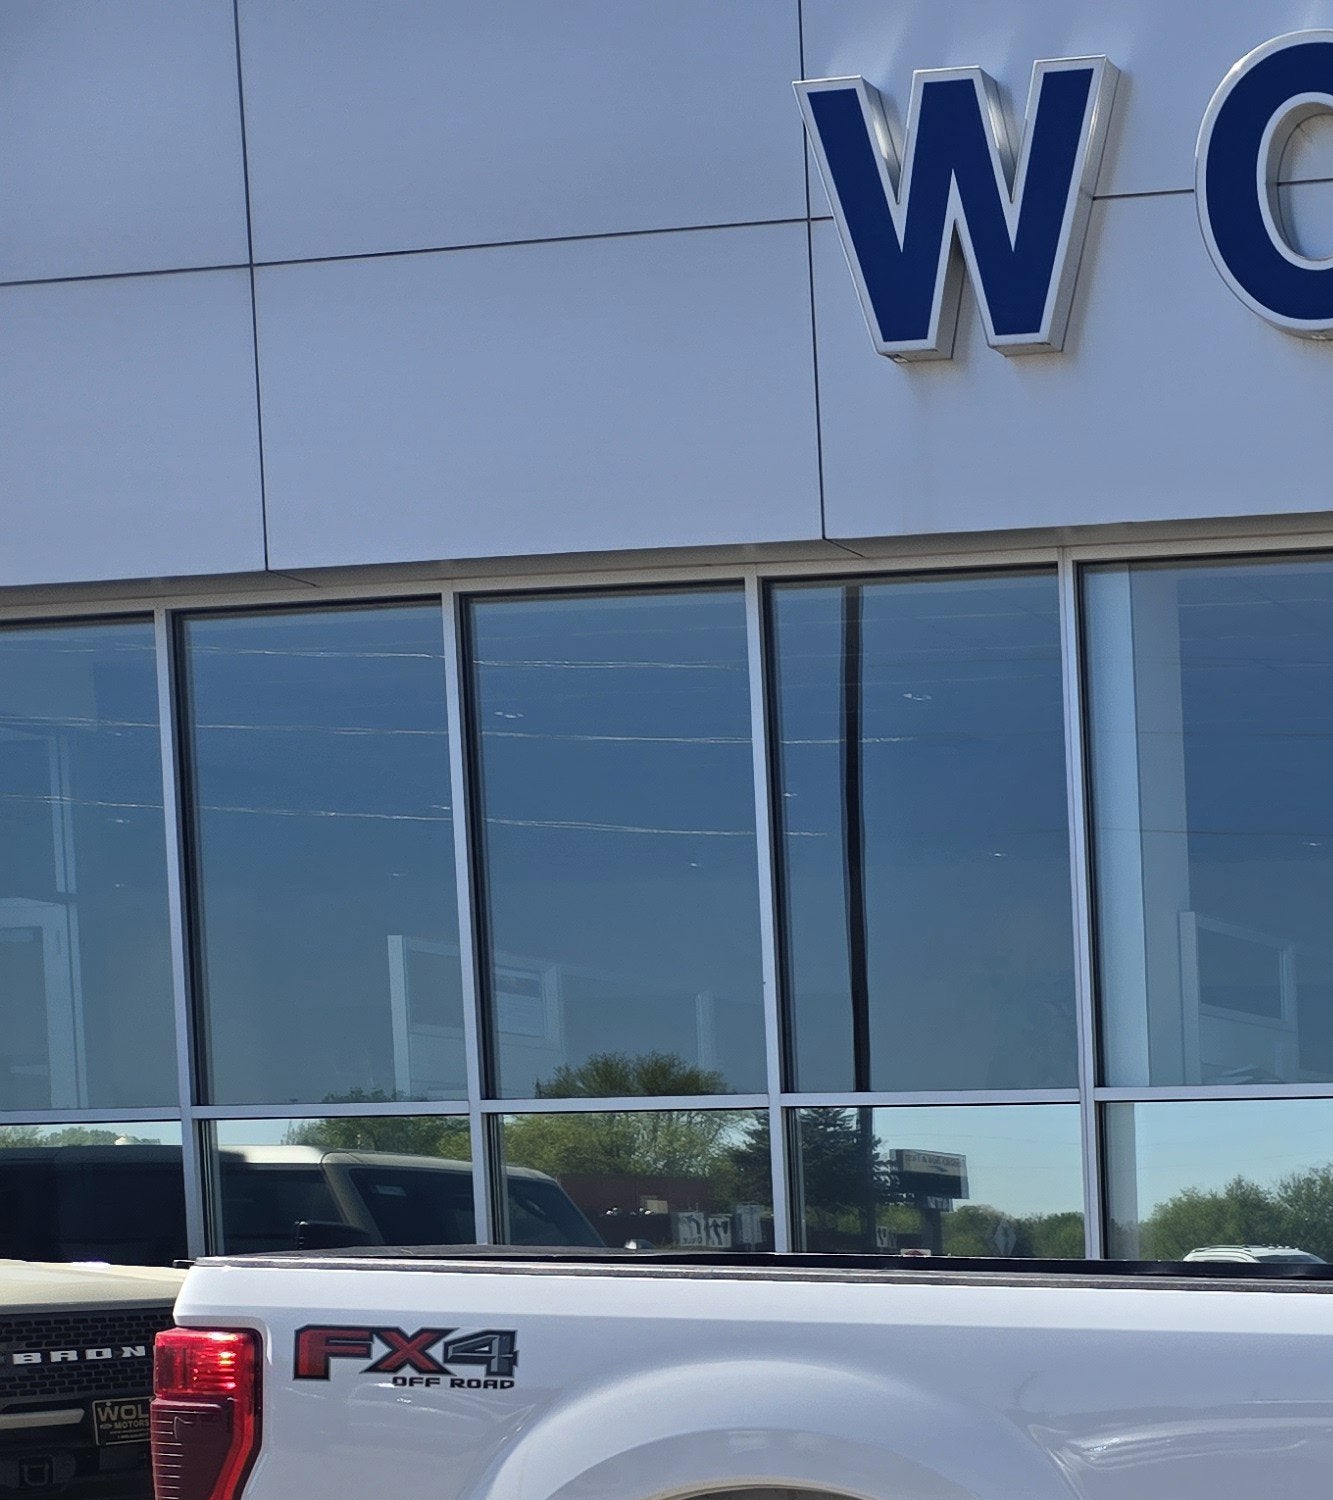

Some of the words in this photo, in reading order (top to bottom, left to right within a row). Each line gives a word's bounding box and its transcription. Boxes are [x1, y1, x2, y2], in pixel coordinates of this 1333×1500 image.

[292, 1324, 518, 1381] FX4
[392, 1375, 441, 1387] OFF
[450, 1377, 515, 1389] ROAD
